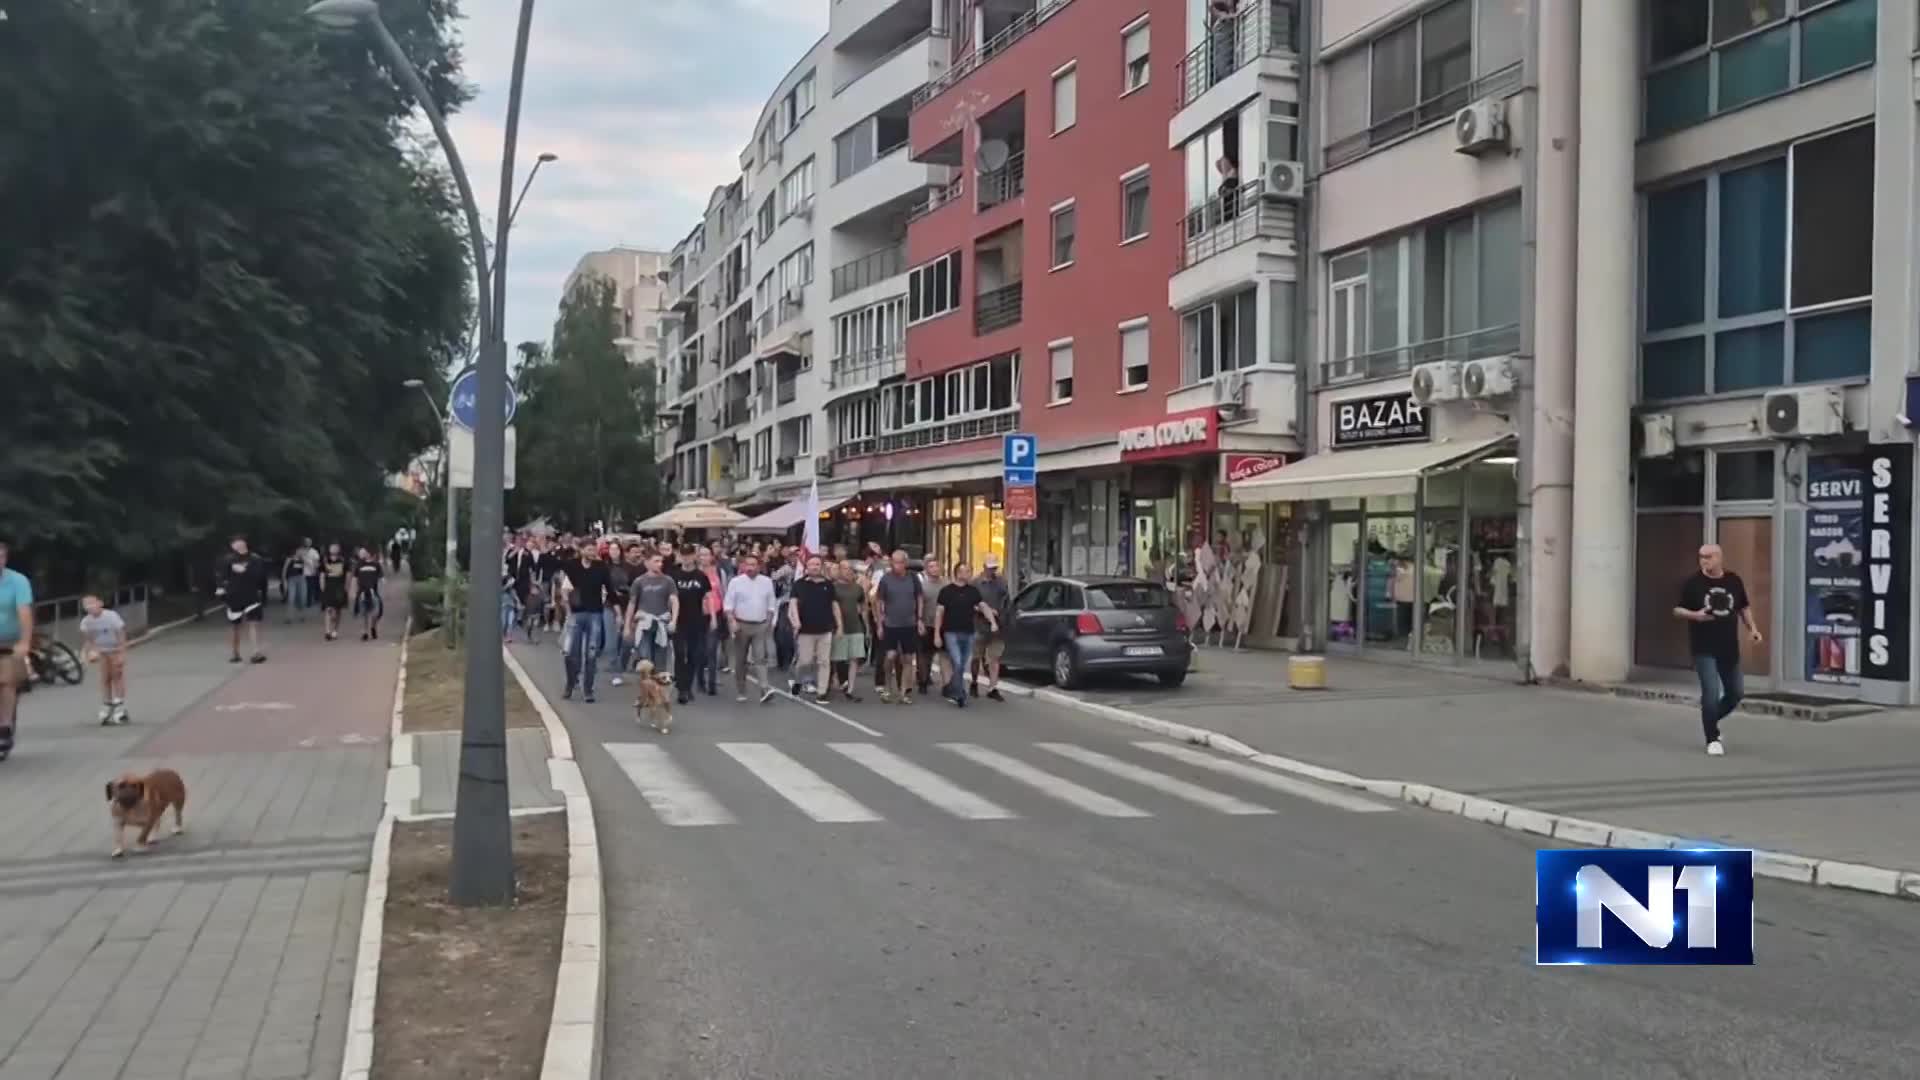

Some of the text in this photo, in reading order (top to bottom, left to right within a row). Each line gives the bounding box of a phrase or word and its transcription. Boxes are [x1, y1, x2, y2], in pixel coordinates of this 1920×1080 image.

[1340, 399, 1423, 430] BAZAR
[1156, 417, 1207, 446] COLOR
[1012, 439, 1029, 464] P
[1869, 457, 1892, 666] SERVIS
